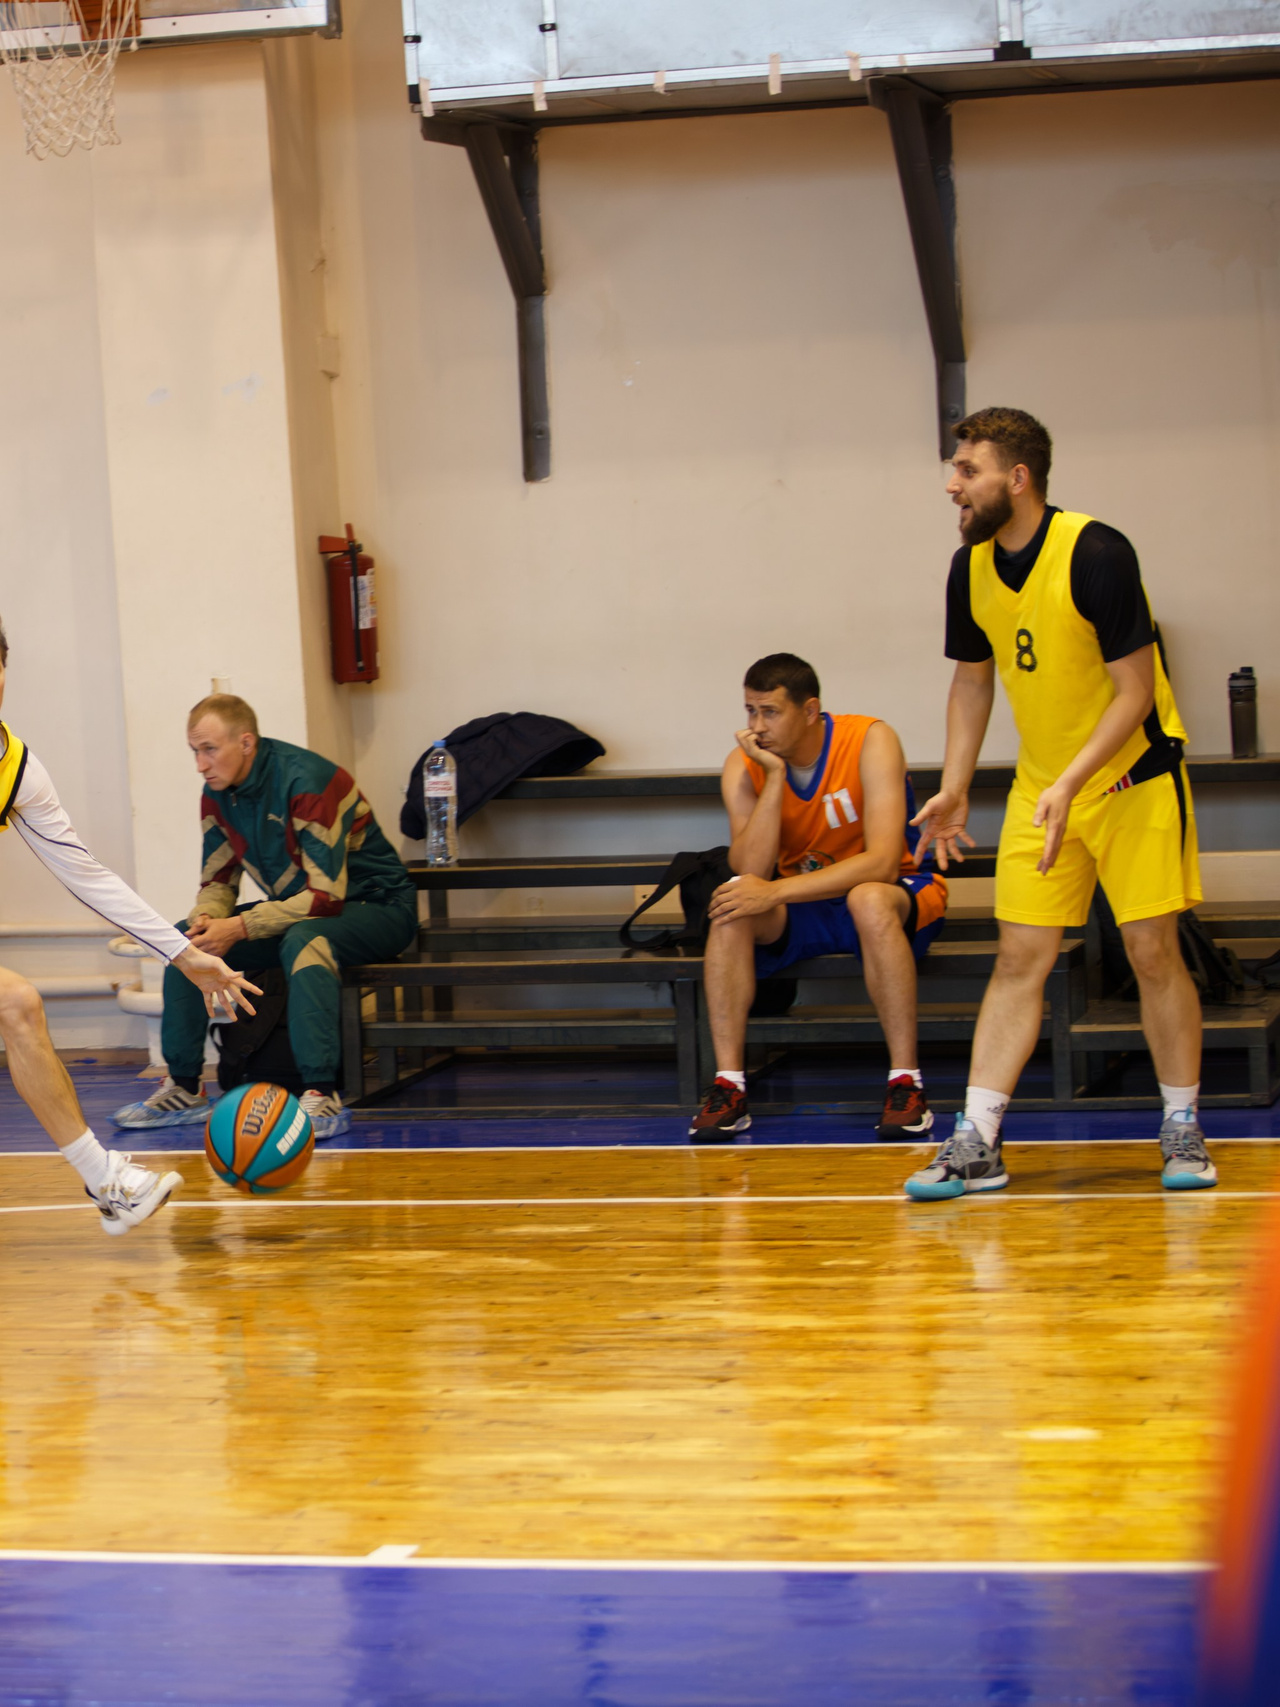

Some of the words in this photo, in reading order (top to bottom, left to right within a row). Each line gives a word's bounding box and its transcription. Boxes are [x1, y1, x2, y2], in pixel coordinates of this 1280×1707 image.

[1015, 628, 1038, 673] 8
[822, 787, 859, 829] 11
[241, 1084, 280, 1137] Wilso
